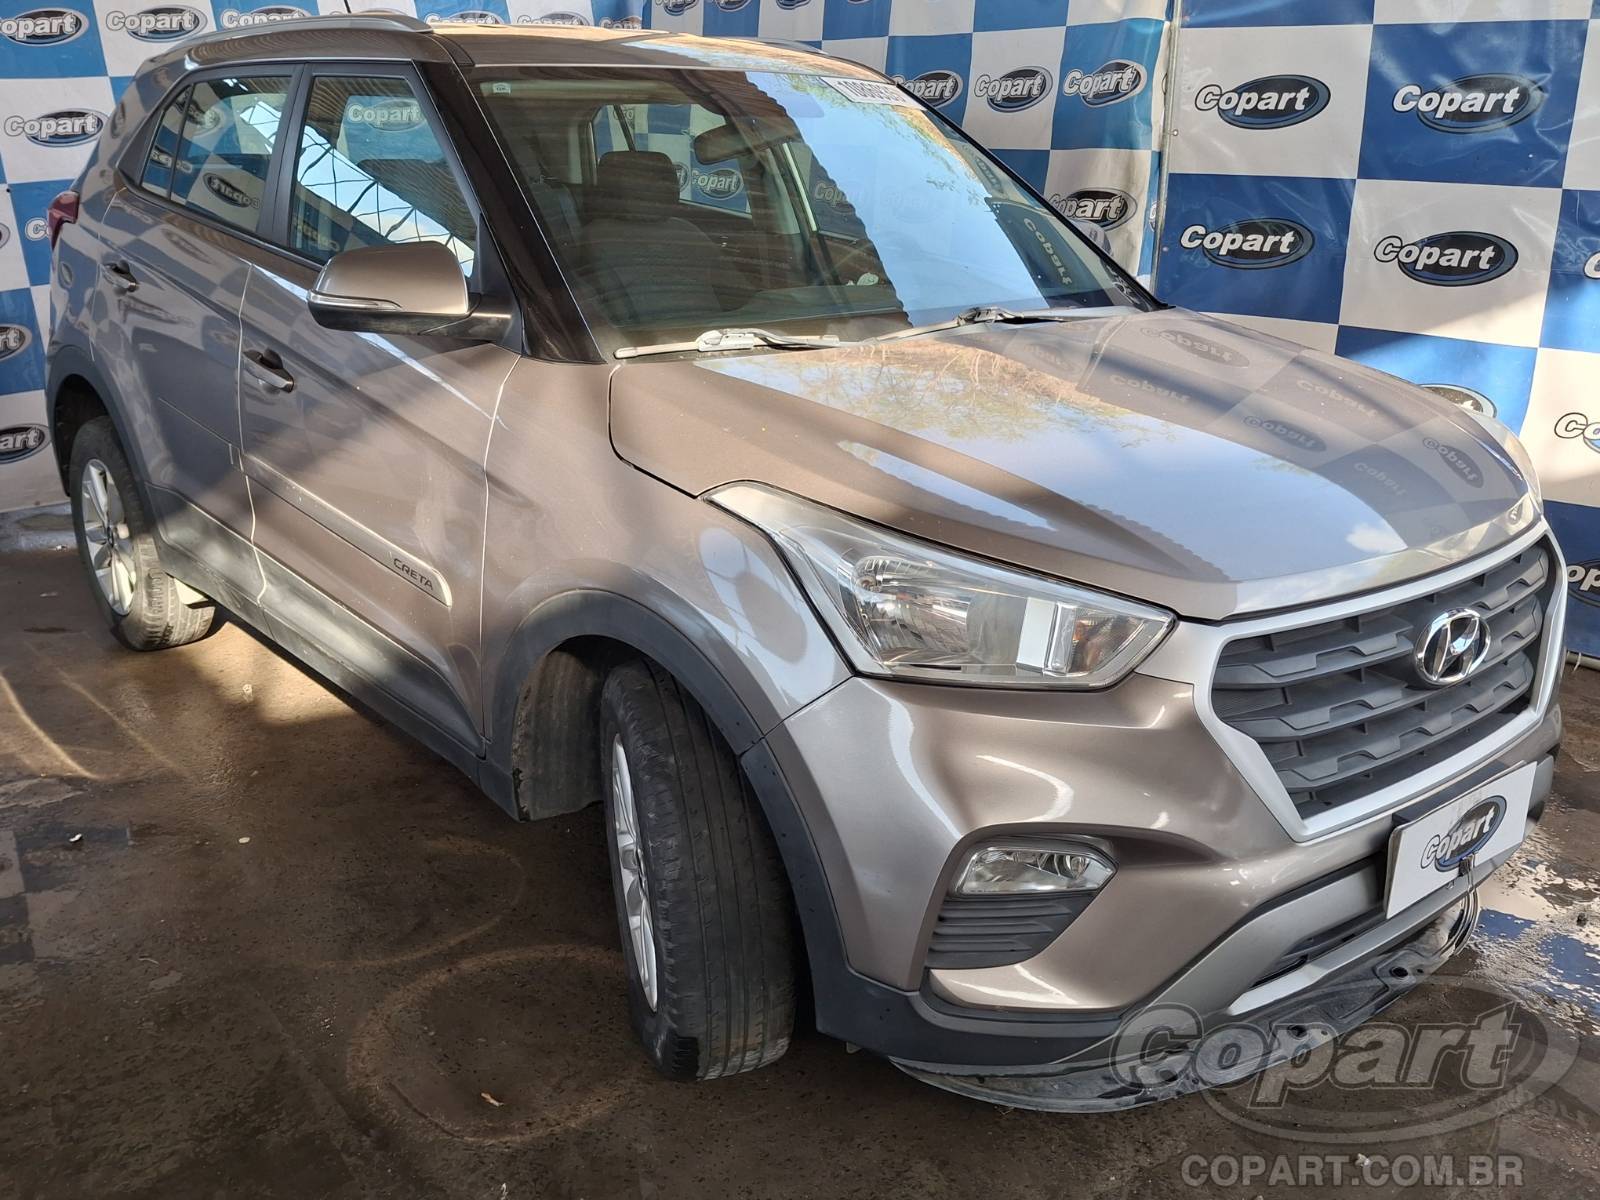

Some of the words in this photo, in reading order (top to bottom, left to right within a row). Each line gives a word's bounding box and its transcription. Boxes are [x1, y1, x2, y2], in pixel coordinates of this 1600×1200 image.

[0, 13, 77, 40] opart
[106, 10, 195, 35] Copart
[975, 73, 1043, 103] Copart
[1064, 64, 1136, 101] Copart
[347, 103, 420, 128] Copart
[1195, 84, 1311, 117] Copart
[1392, 84, 1521, 122] Copart
[5, 113, 98, 140] Copart
[1180, 224, 1297, 256] Copart
[1374, 235, 1496, 270] Copart
[393, 558, 434, 591] CRETA
[1421, 804, 1496, 869] Copart
